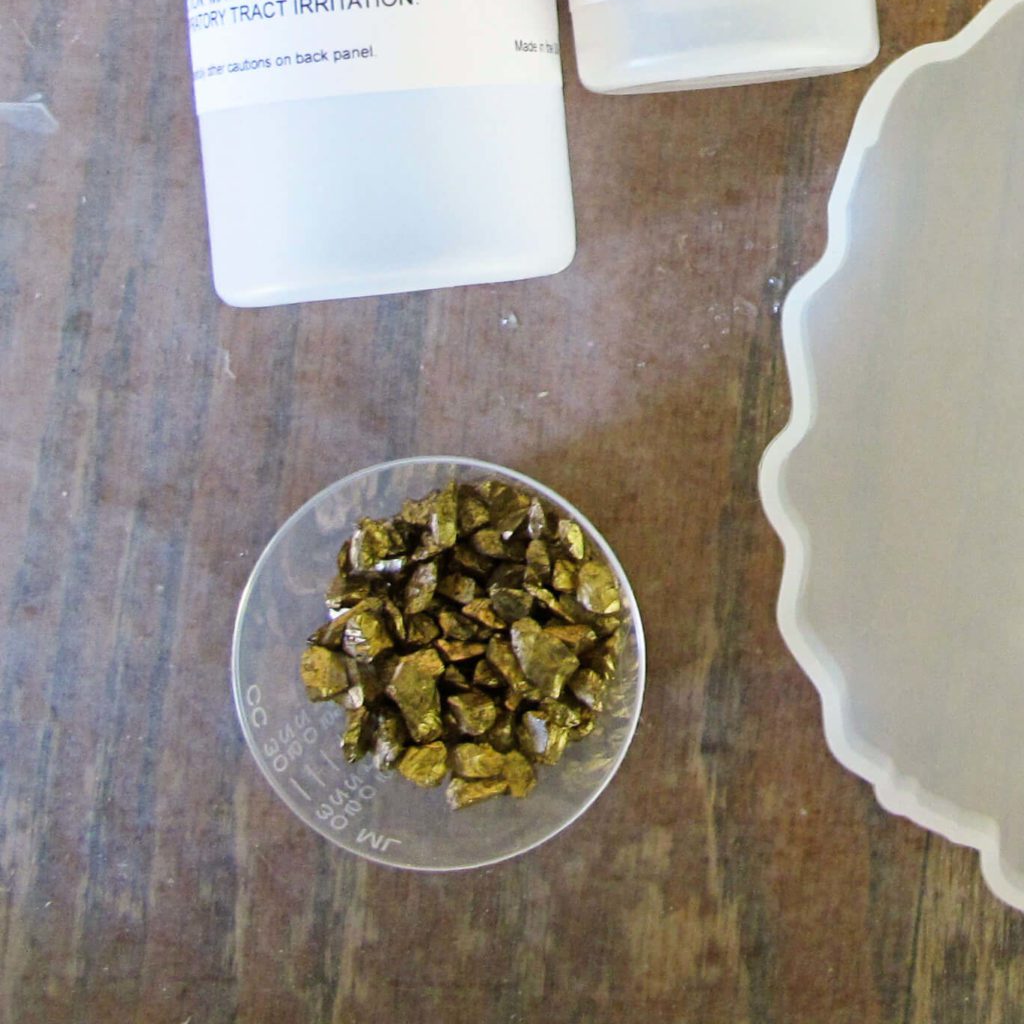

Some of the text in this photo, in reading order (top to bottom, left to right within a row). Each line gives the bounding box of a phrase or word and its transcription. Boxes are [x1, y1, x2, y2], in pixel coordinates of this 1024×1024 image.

[230, 0, 287, 24] TRACT
[227, 56, 272, 73] cautions
[276, 55, 292, 67] on
[296, 49, 329, 65] back
